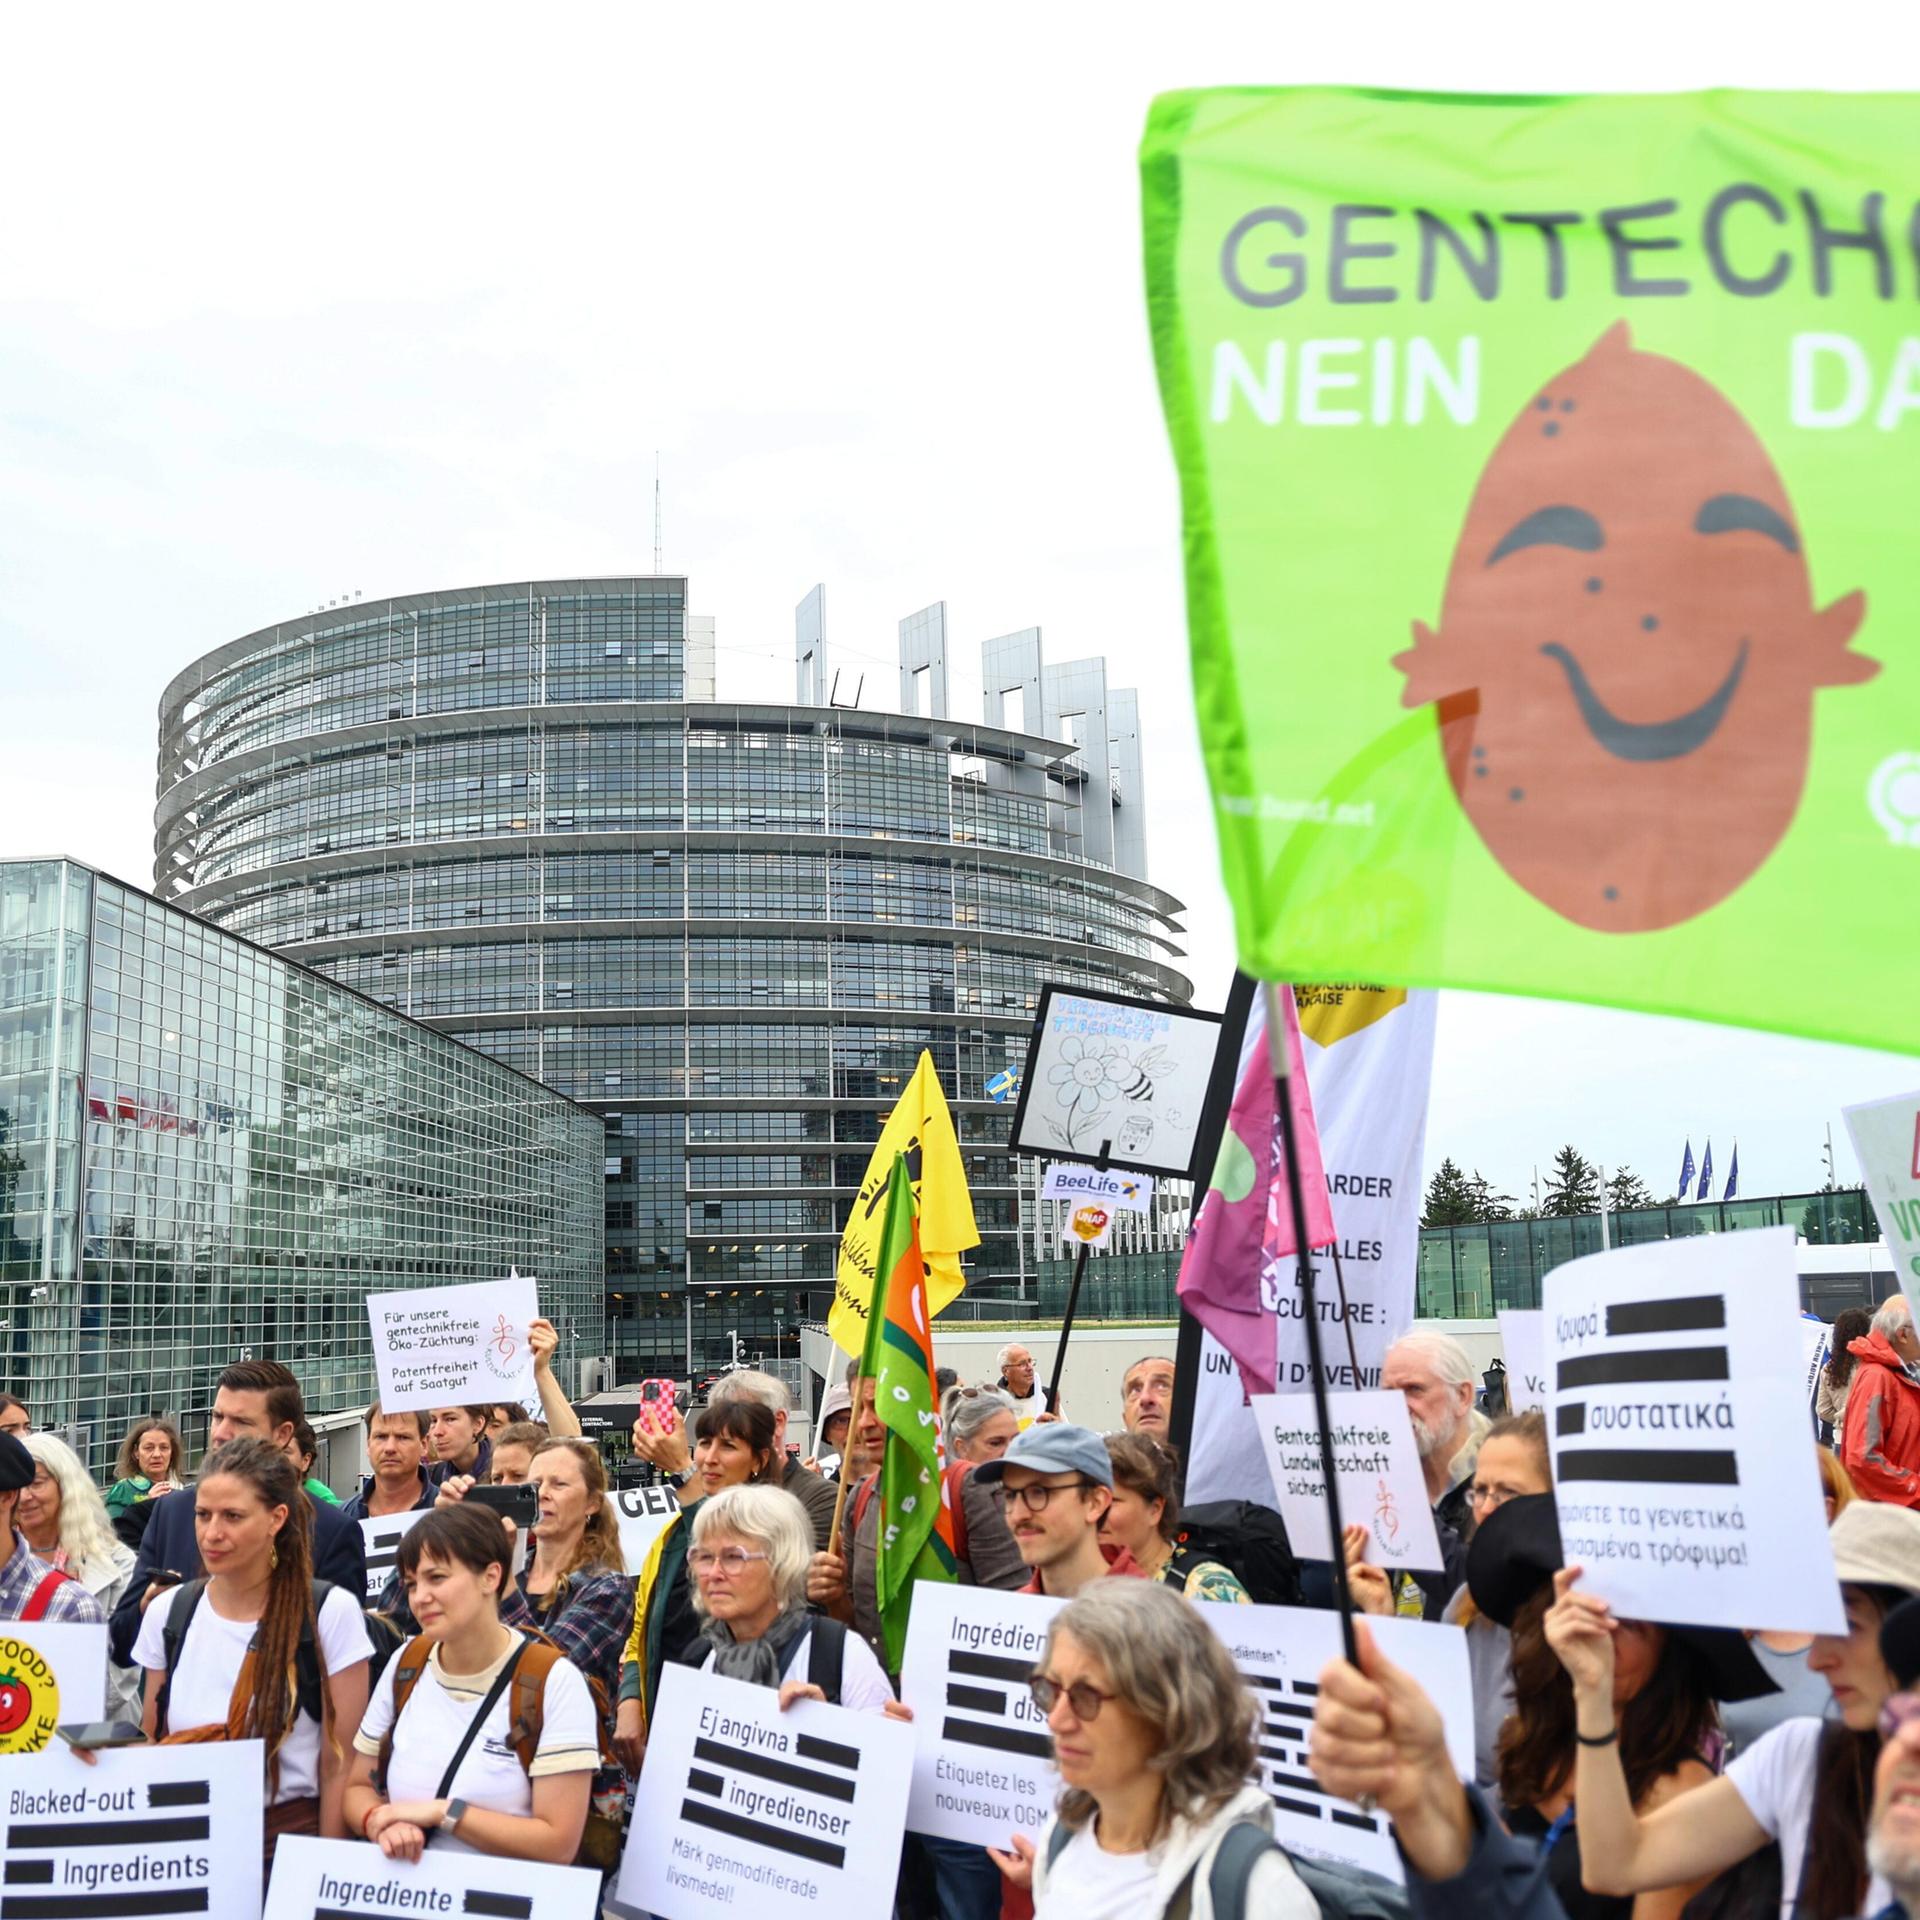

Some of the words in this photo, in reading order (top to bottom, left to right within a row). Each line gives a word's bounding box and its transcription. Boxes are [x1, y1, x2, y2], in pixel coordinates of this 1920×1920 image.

[1219, 181, 1920, 309] GENTECH
[1209, 335, 1482, 427] NEIN
[1055, 1174, 1119, 1193] BeeLife
[384, 1312, 405, 1324] Für
[410, 1309, 449, 1322] unsere
[1277, 1297, 1374, 1324] CUTURE
[386, 1319, 481, 1341] gentechnikfreie
[388, 1334, 479, 1352] Öko-Züchtung:
[391, 1360, 479, 1379] Patentfreiheit
[1205, 1352, 1233, 1375] UN
[394, 1382, 413, 1393] auf
[420, 1376, 468, 1391] Saatgut
[1591, 1392, 1735, 1429] συστατικά
[1274, 1425, 1392, 1446] Gentecnikfreie
[1279, 1451, 1390, 1473] Landwischaft
[0, 1640, 55, 1688] OOD?
[1014, 1695, 1049, 1723] dis
[699, 1706, 719, 1737] Ej
[720, 1717, 789, 1753] angivna
[935, 1755, 1008, 1791] Étiquetez
[1013, 1773, 1037, 1796] les
[9, 1787, 136, 1816] Blacked-out
[729, 1780, 851, 1836] ingredienser
[935, 1793, 1010, 1821] nouveaux
[64, 1854, 209, 1891] Ingredients
[671, 1837, 702, 1859] Märk
[705, 1851, 818, 1900] genmodifierade
[318, 1873, 453, 1912] Ingrediente
[665, 1864, 735, 1904] livsmedel!
